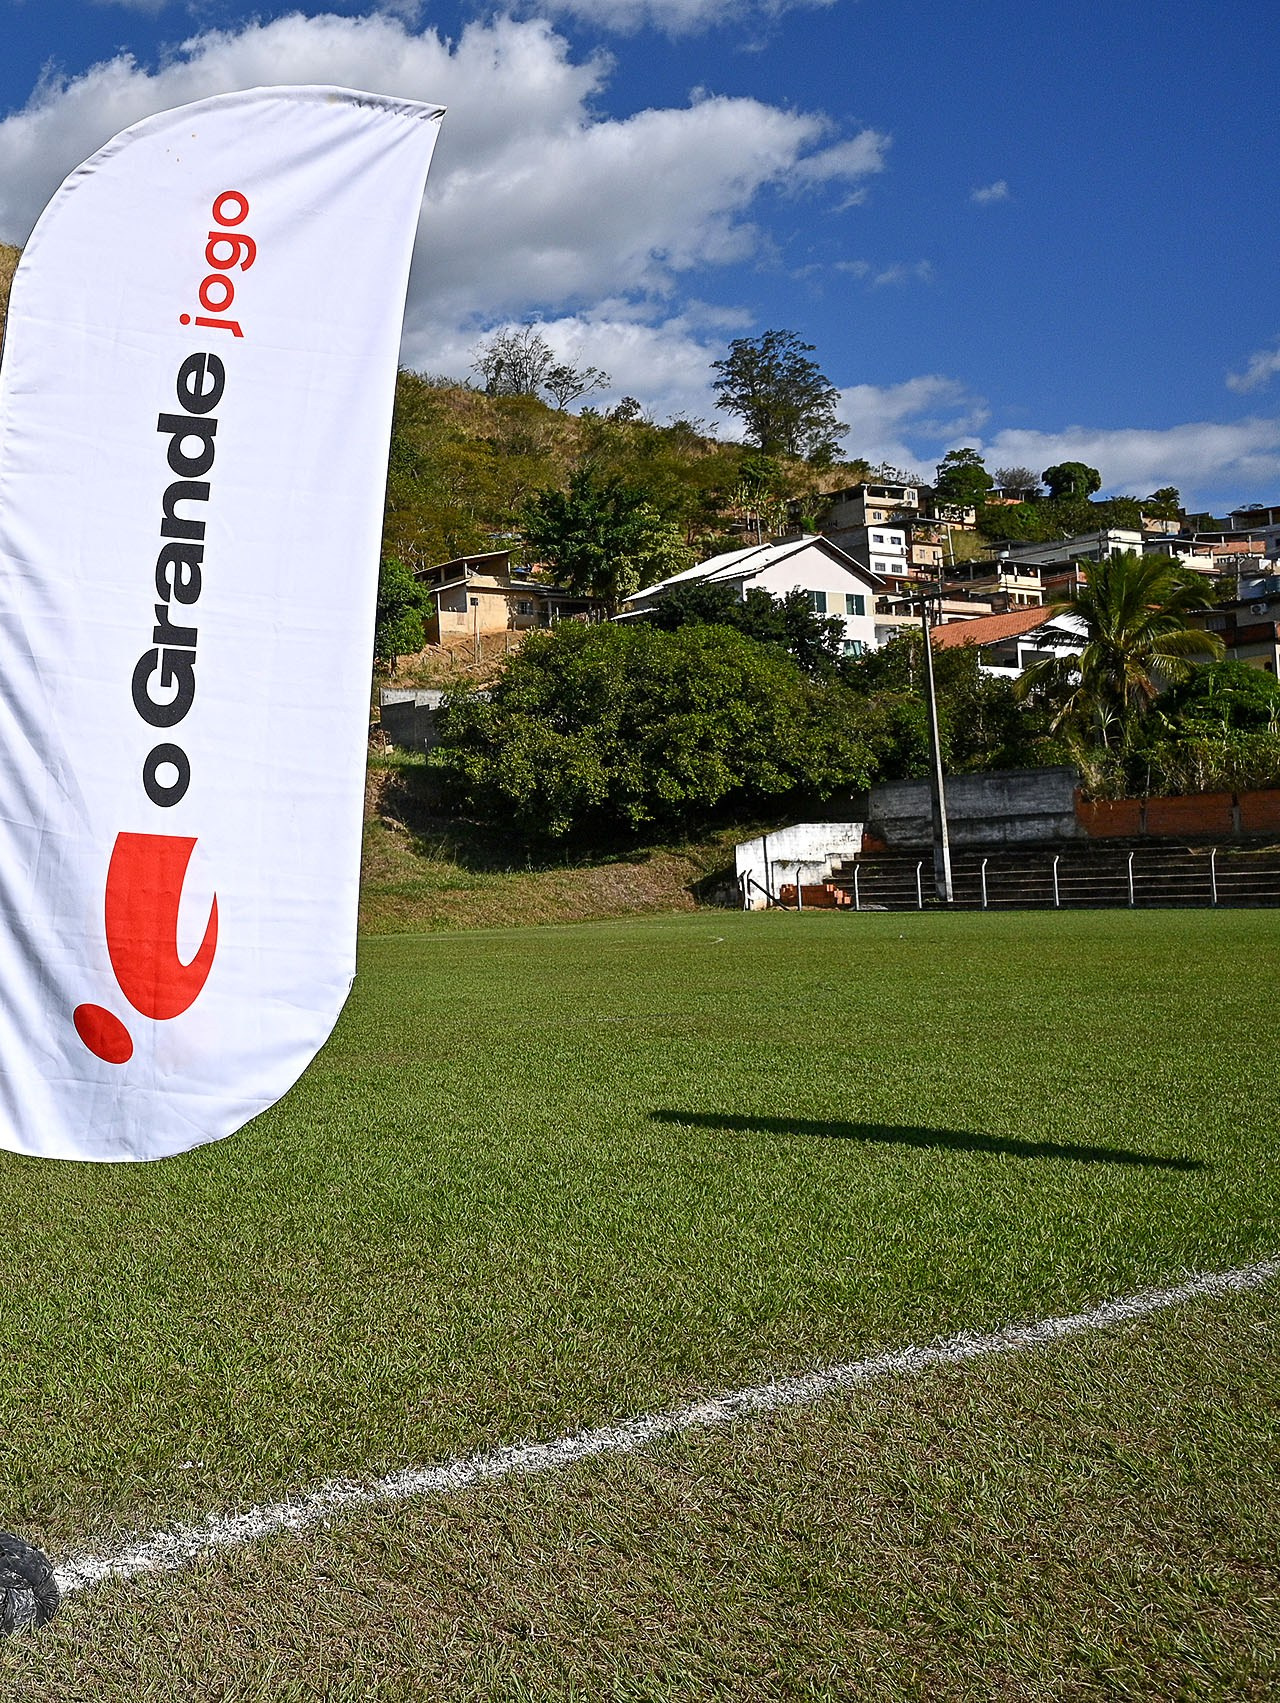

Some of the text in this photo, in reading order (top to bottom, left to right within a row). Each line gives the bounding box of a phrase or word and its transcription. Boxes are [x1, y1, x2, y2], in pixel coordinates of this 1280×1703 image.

[131, 190, 257, 808] o Grande jogo
